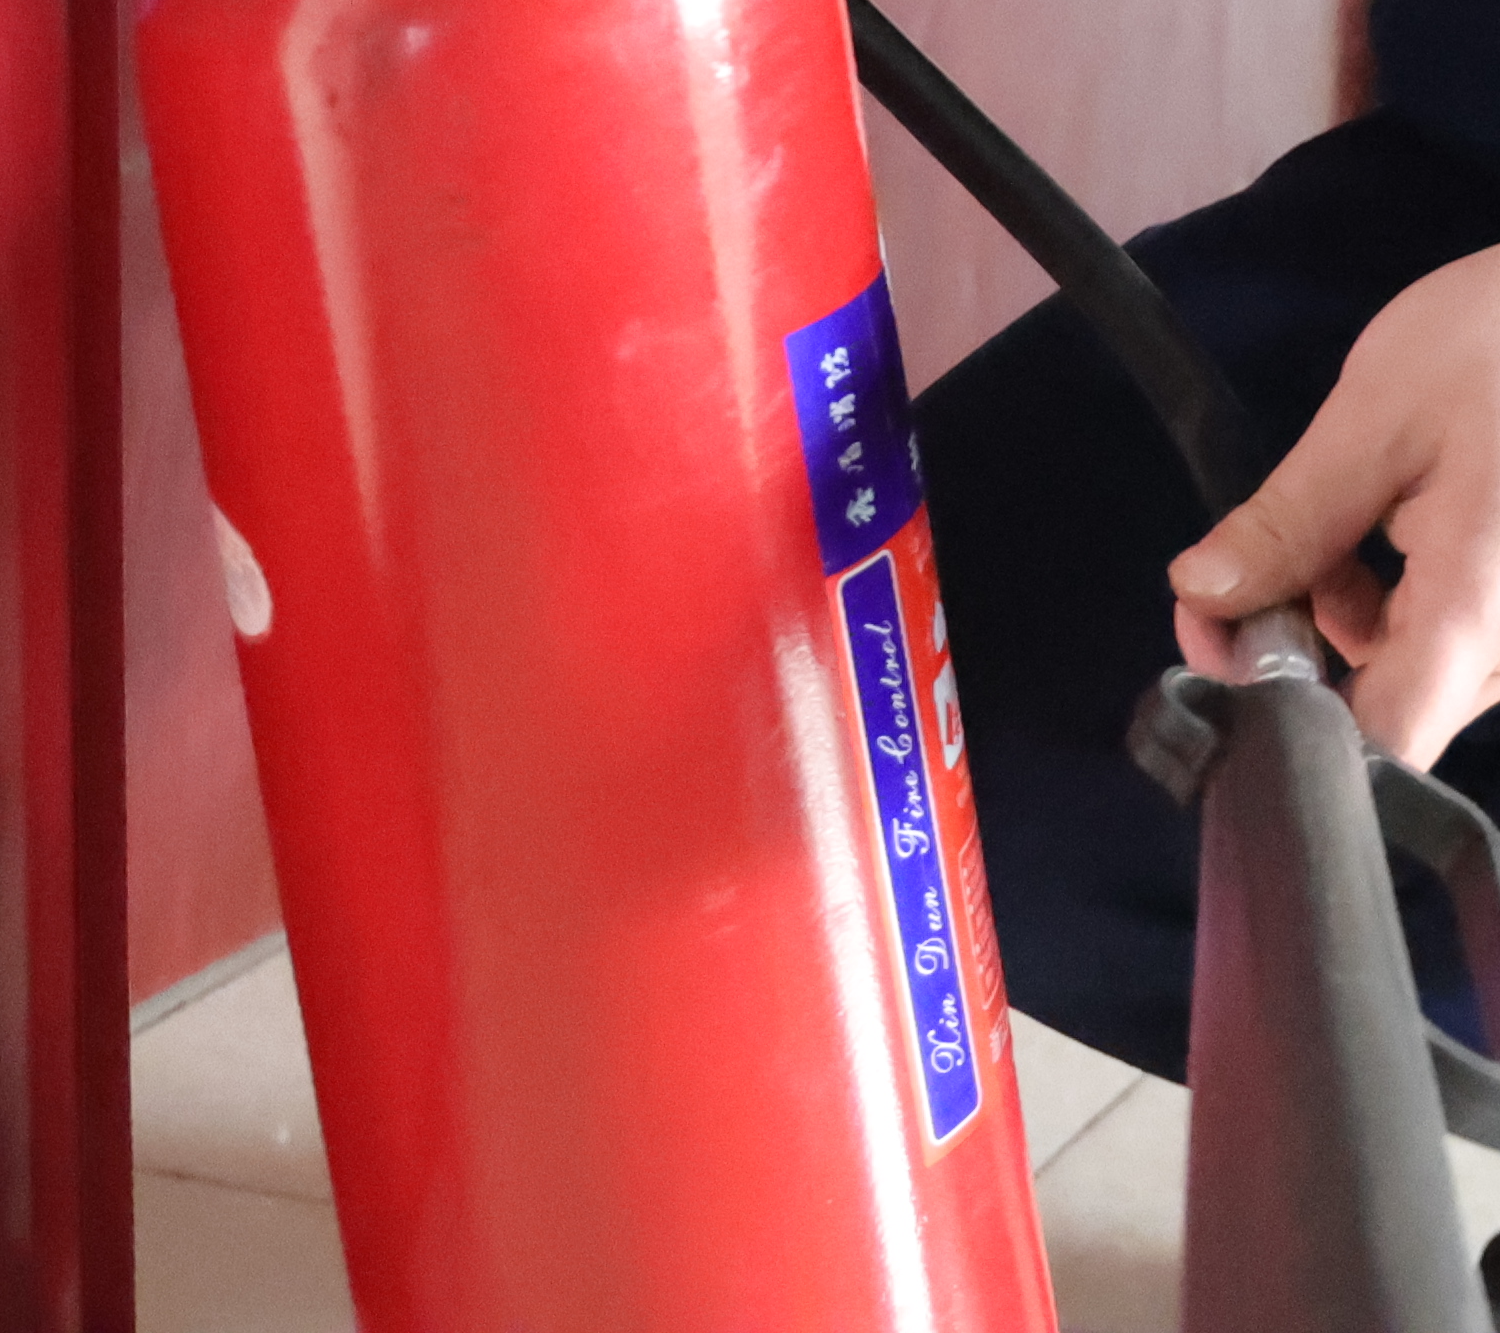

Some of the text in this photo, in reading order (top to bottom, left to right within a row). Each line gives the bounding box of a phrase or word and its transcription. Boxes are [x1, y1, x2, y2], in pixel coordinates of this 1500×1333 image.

[864, 619, 966, 1075] Xin Dun Fire Control
